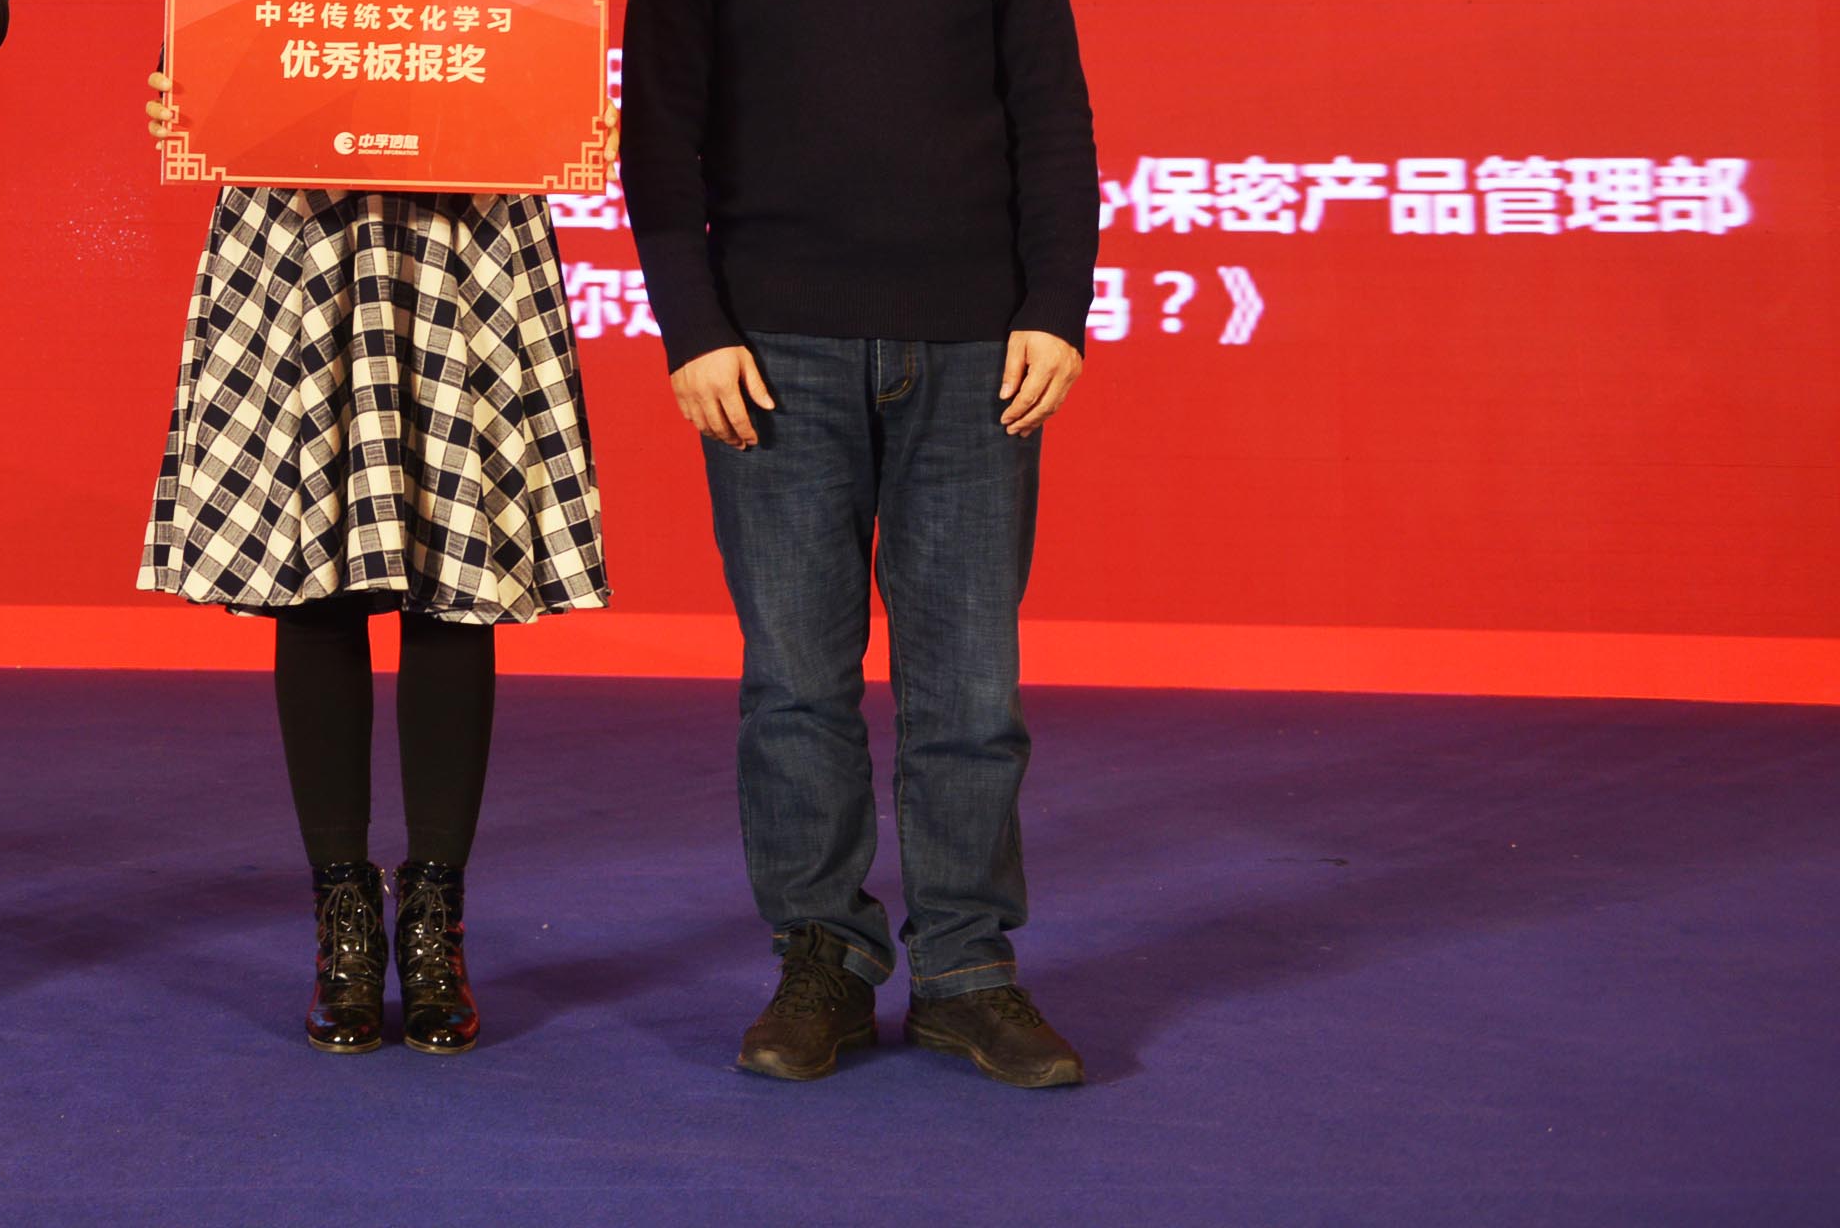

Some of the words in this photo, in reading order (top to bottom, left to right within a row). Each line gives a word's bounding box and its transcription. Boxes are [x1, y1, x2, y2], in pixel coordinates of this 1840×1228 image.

[255, 0, 512, 33] 中华传统文化学习
[280, 39, 486, 84] 优秀板报奖
[358, 133, 419, 149] 中孚信息
